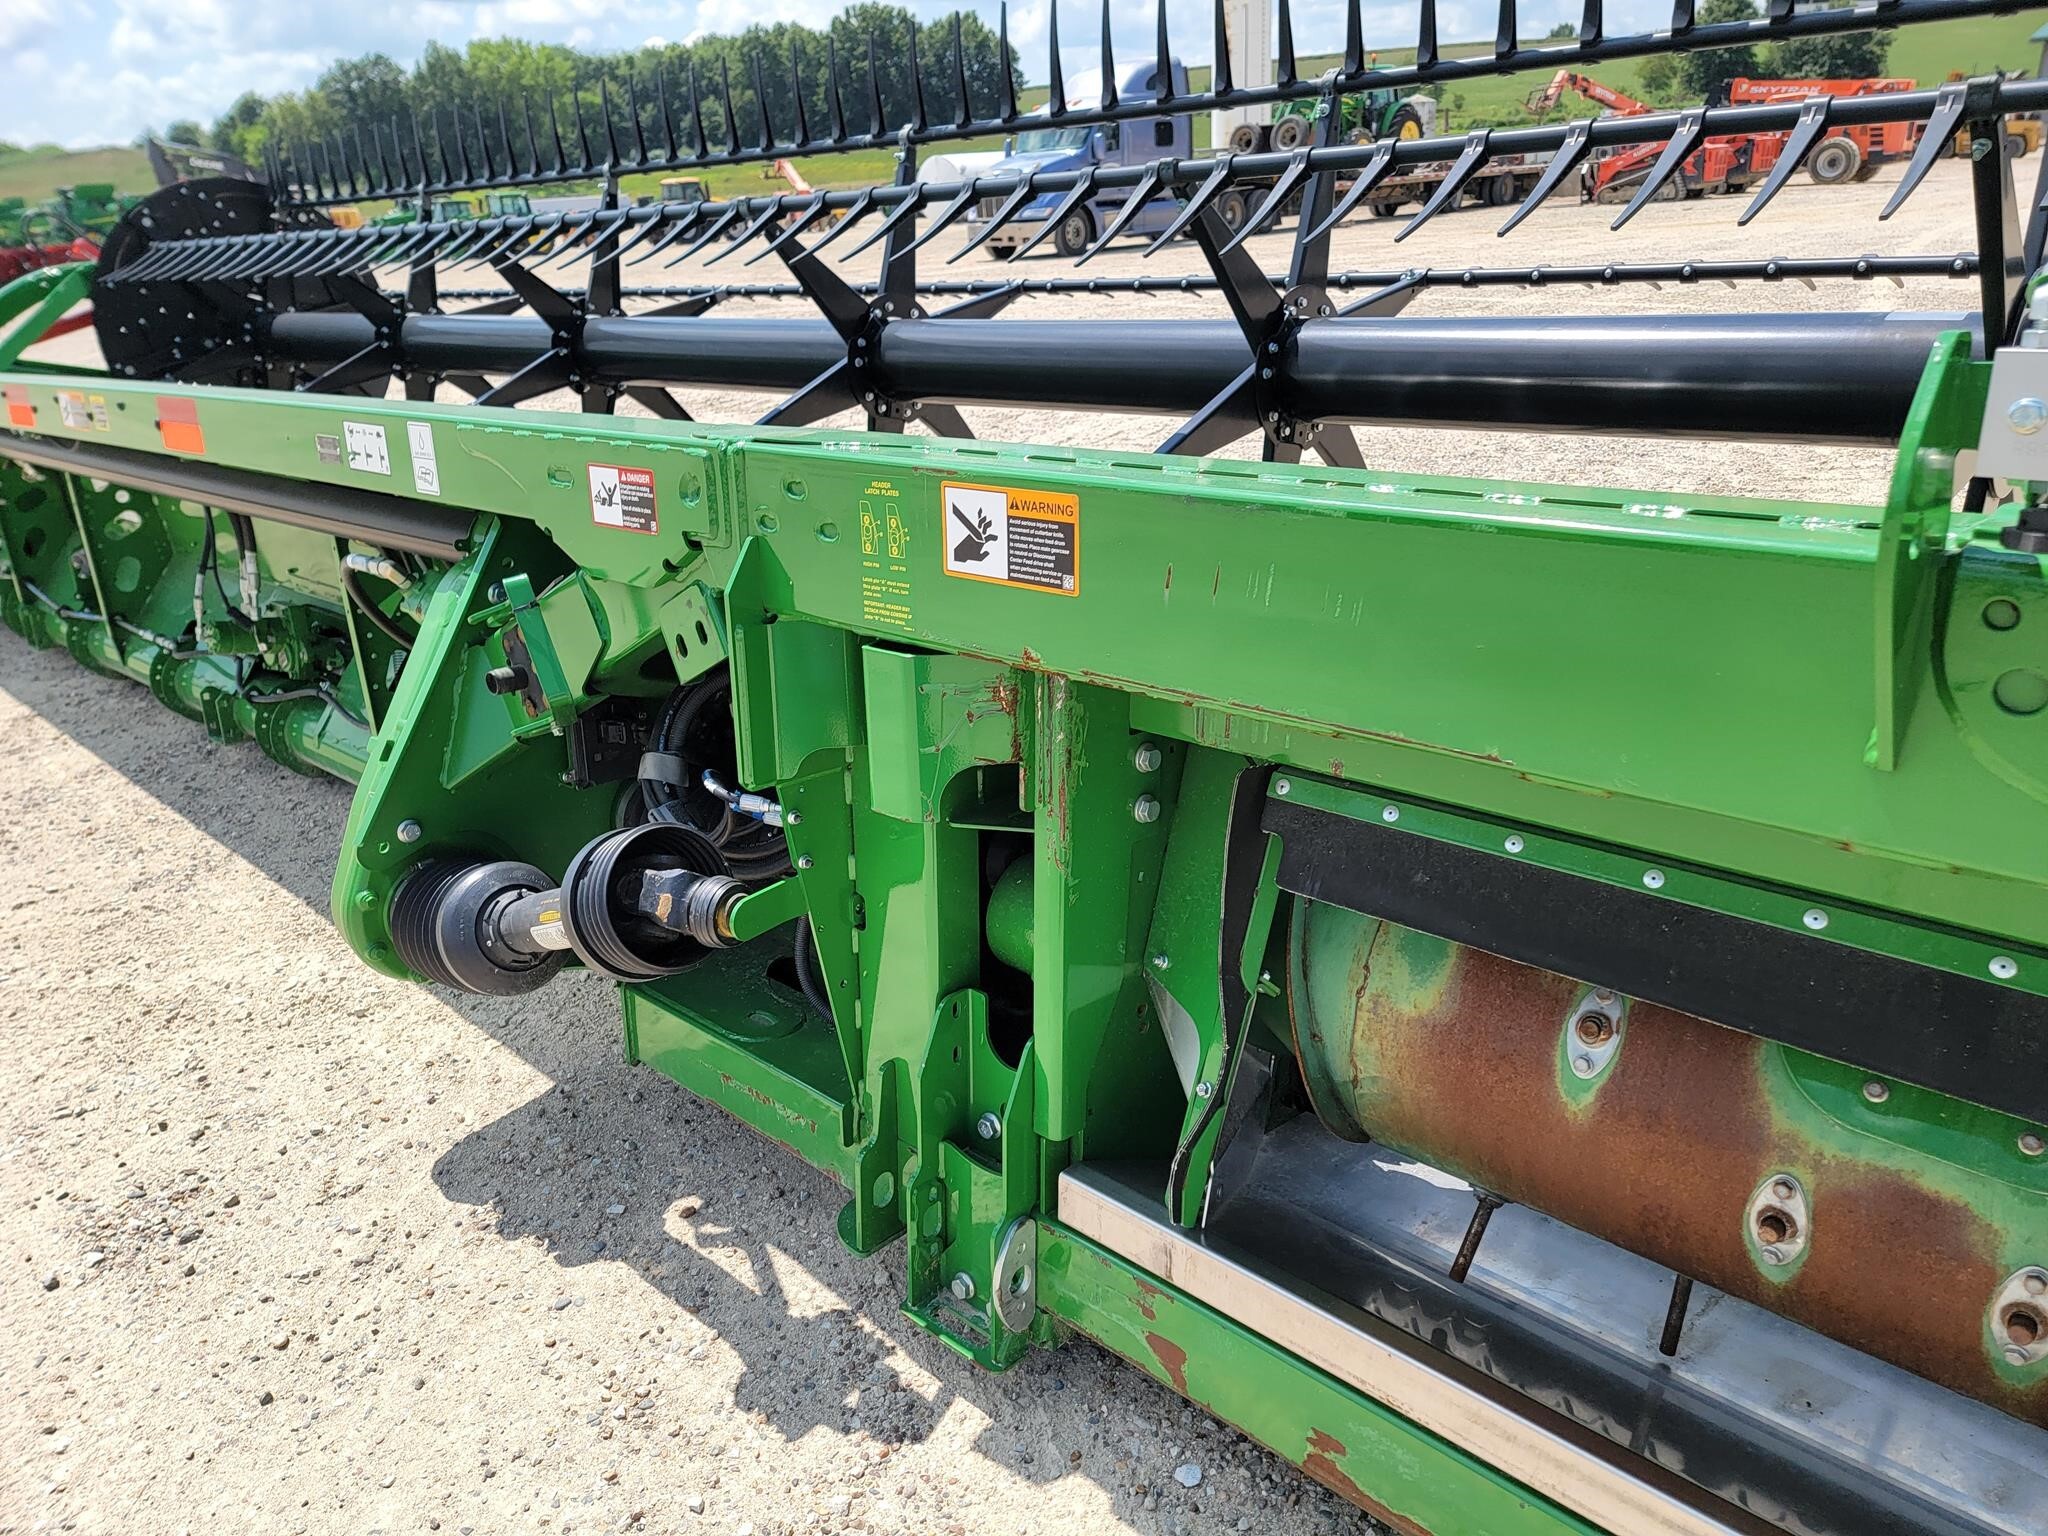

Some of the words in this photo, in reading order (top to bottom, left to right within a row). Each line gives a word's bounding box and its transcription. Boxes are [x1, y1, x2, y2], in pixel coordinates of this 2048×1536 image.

[1750, 85, 1822, 94] SKYTRAK
[626, 472, 650, 484] DANGER
[1021, 500, 1074, 517] WARNING
